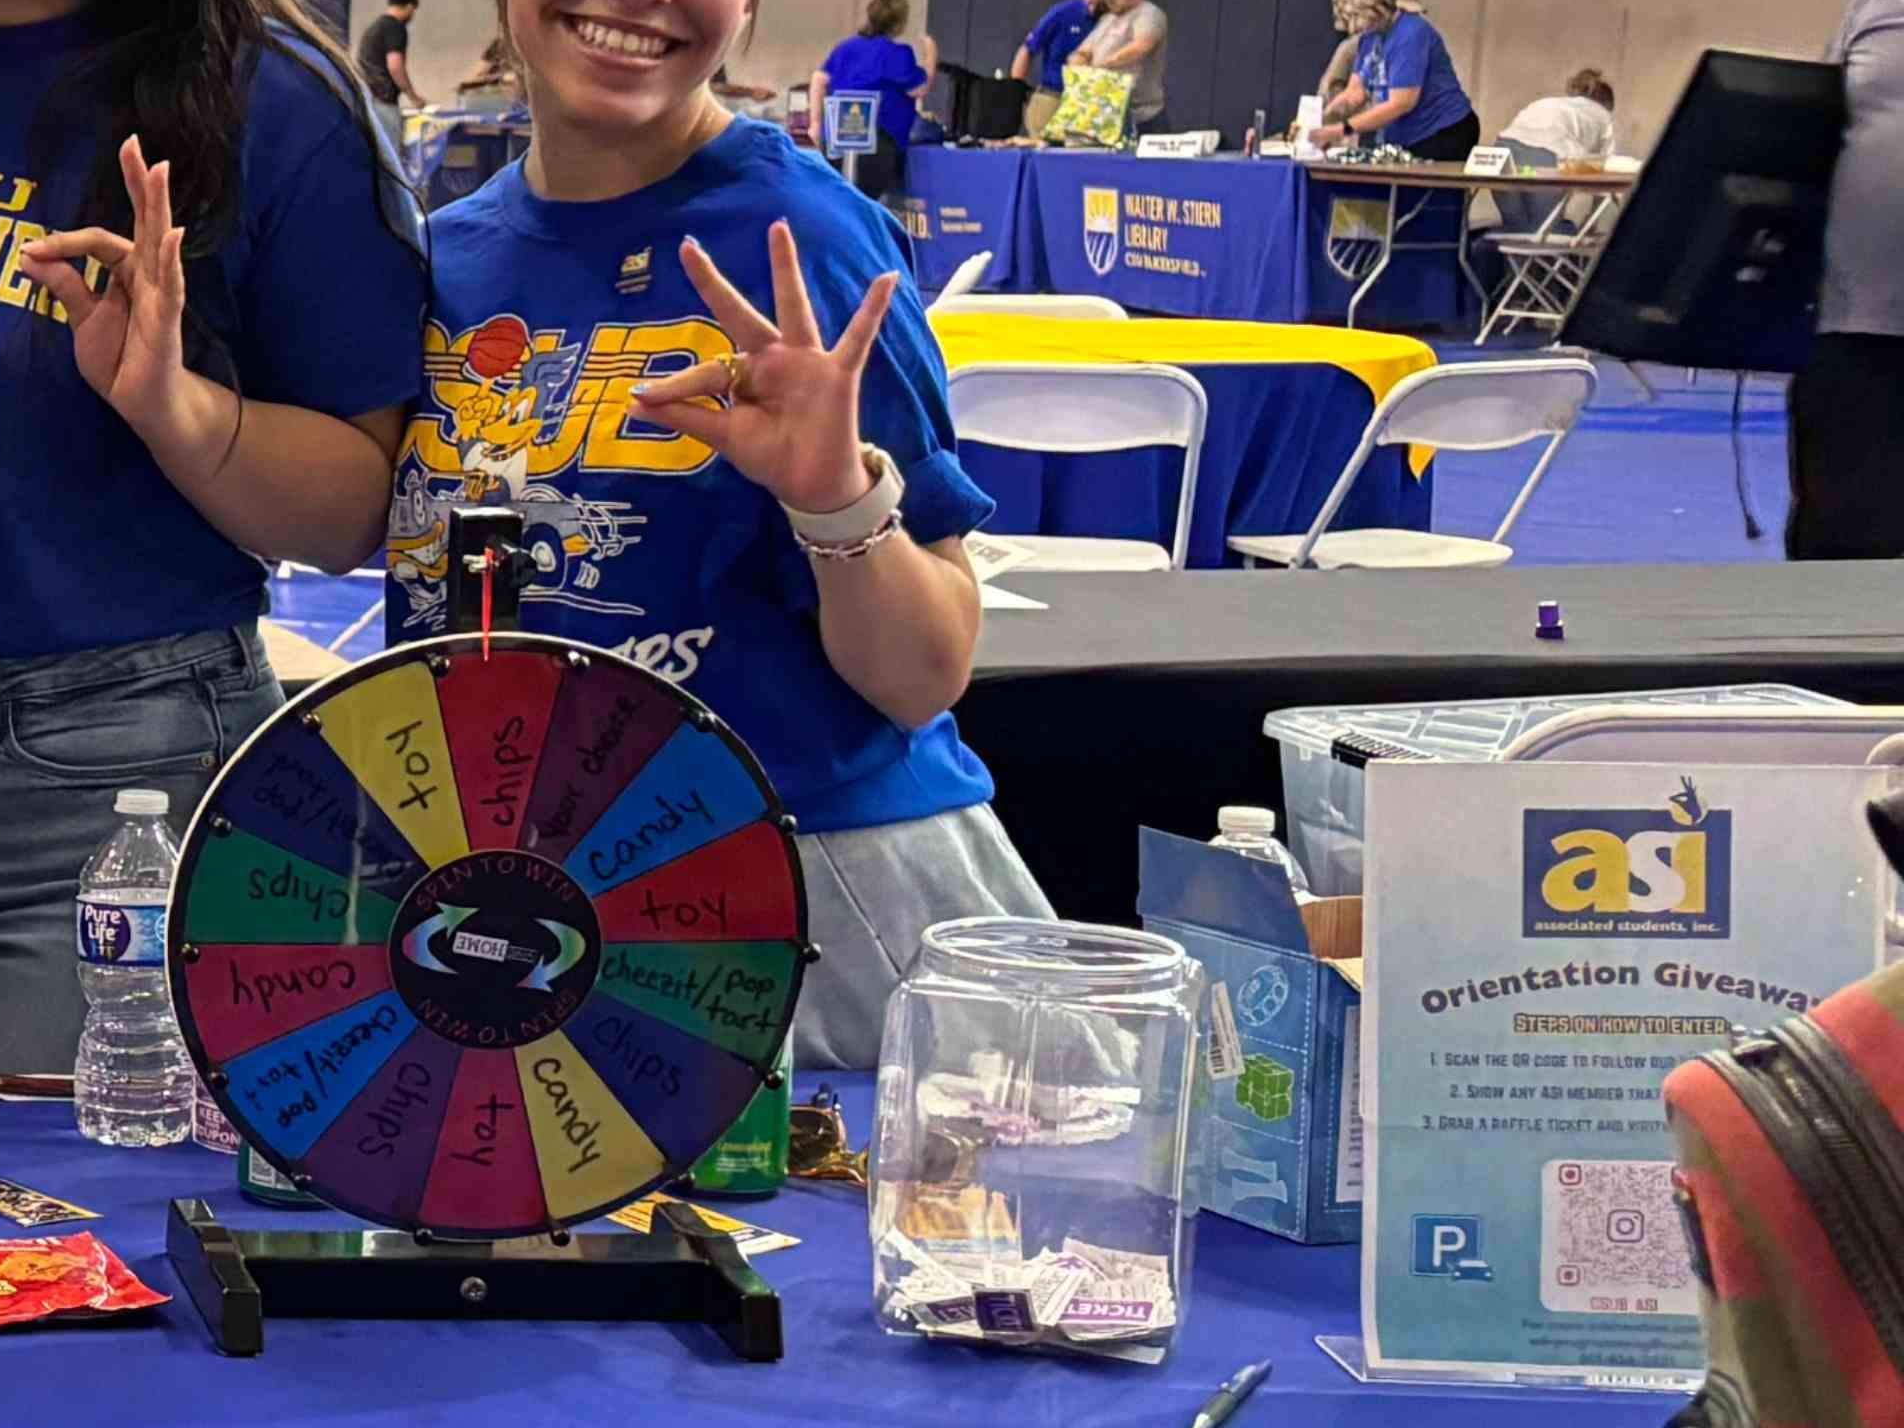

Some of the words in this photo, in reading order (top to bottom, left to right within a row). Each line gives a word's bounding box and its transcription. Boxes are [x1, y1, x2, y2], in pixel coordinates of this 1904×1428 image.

[1124, 194, 1164, 222] WALTER
[481, 715, 533, 826] chips
[248, 862, 350, 923] chips
[416, 866, 473, 908] SPIN
[480, 857, 516, 874] TO
[526, 863, 576, 902] WIN
[1541, 829, 1707, 914] asi
[84, 904, 121, 924] Pure
[87, 919, 117, 945] Life
[639, 888, 728, 933] toy
[1534, 918, 1613, 933] associated
[1617, 919, 1687, 933] students,
[1692, 920, 1721, 933] inc.
[1421, 961, 1640, 1014] Orientation
[477, 1026, 511, 1044] TO
[449, 1094, 515, 1167] toy
